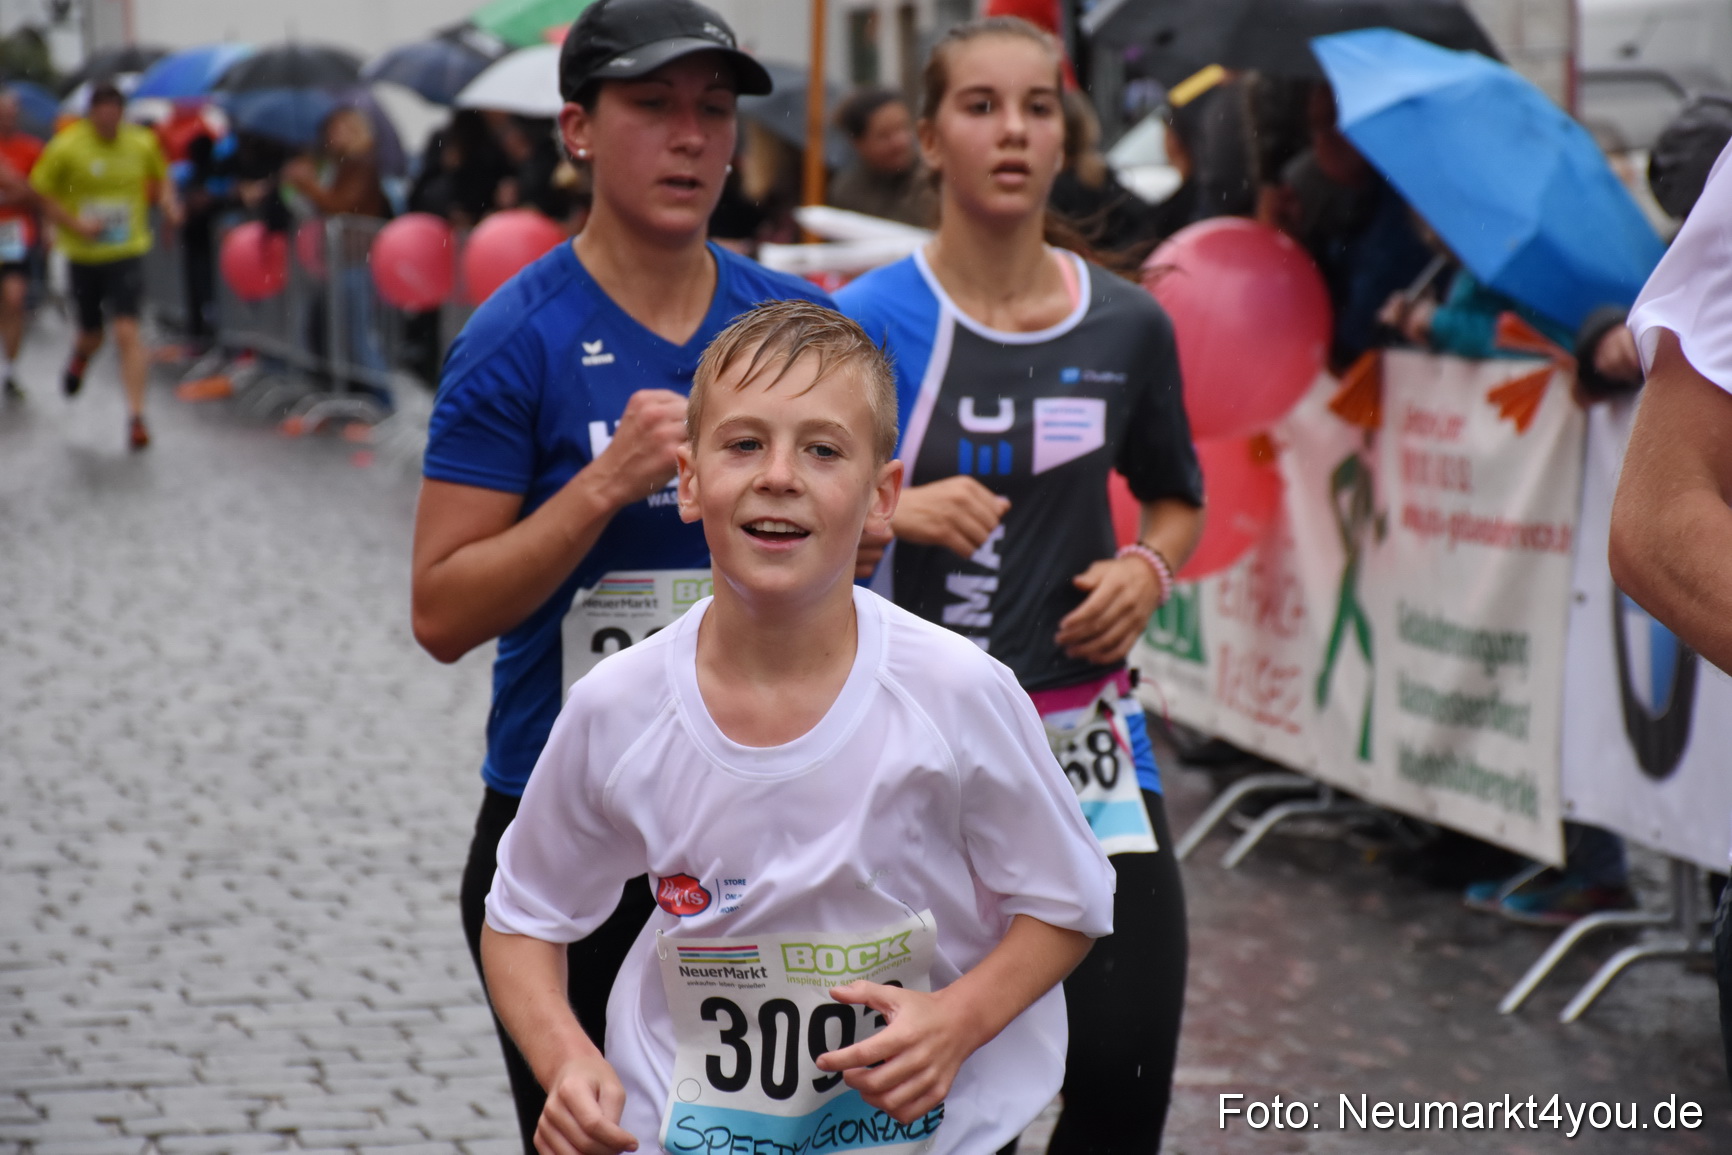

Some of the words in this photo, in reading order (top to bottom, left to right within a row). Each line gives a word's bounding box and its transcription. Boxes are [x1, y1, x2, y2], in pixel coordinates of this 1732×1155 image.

[781, 930, 912, 976] BOCK
[678, 966, 768, 980] NeuerMarkt
[786, 974, 822, 987] inspired
[871, 956, 912, 977] concepts
